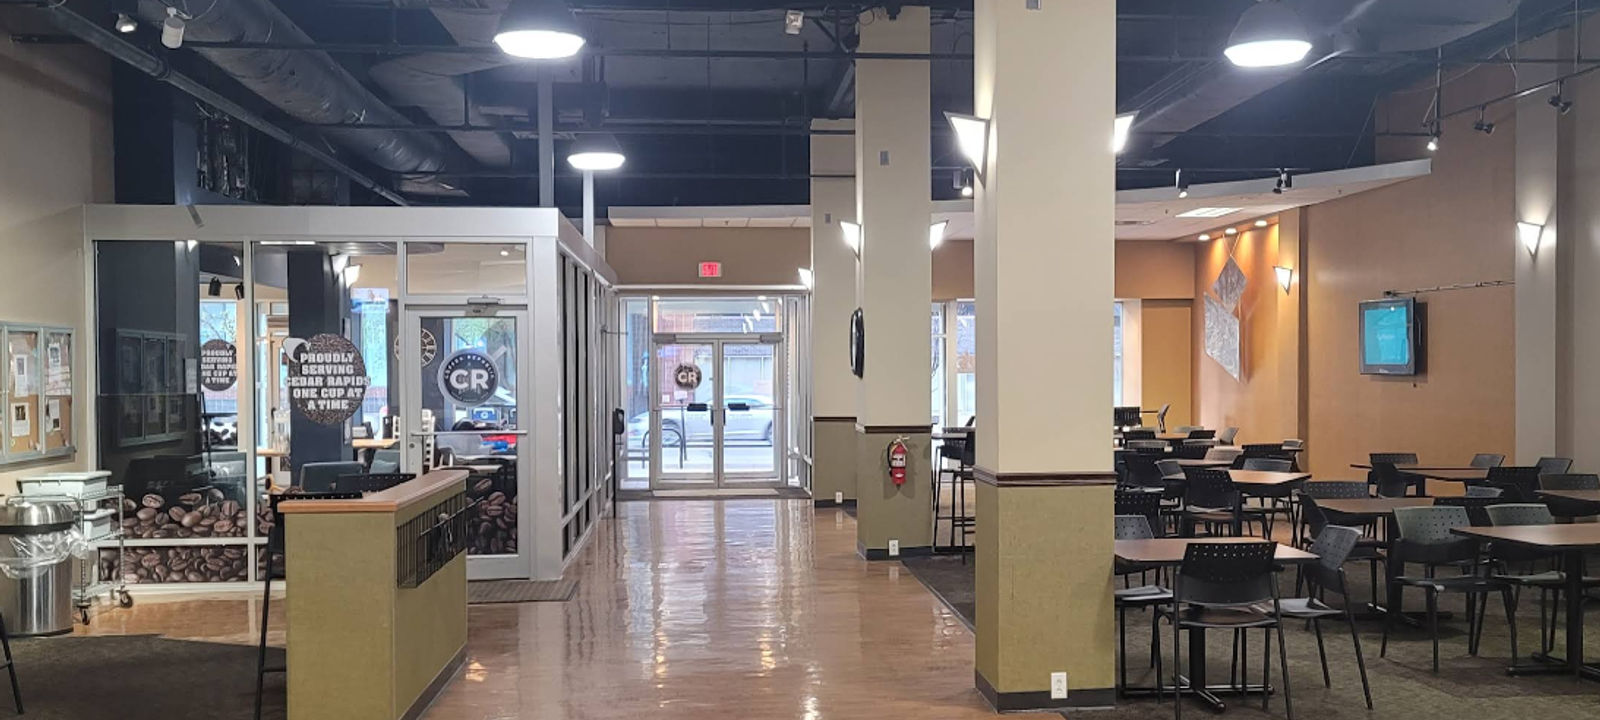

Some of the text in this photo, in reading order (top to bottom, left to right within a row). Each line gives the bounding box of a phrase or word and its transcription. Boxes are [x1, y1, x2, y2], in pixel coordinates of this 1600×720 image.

[300, 352, 355, 364] PROUDLY
[301, 364, 355, 375] SERVING
[326, 376, 371, 387] RAPIDS
[449, 369, 489, 389] CR
[677, 371, 698, 383] CR
[292, 387, 363, 398] ONE CUP AT
[307, 399, 349, 410] A TIME
